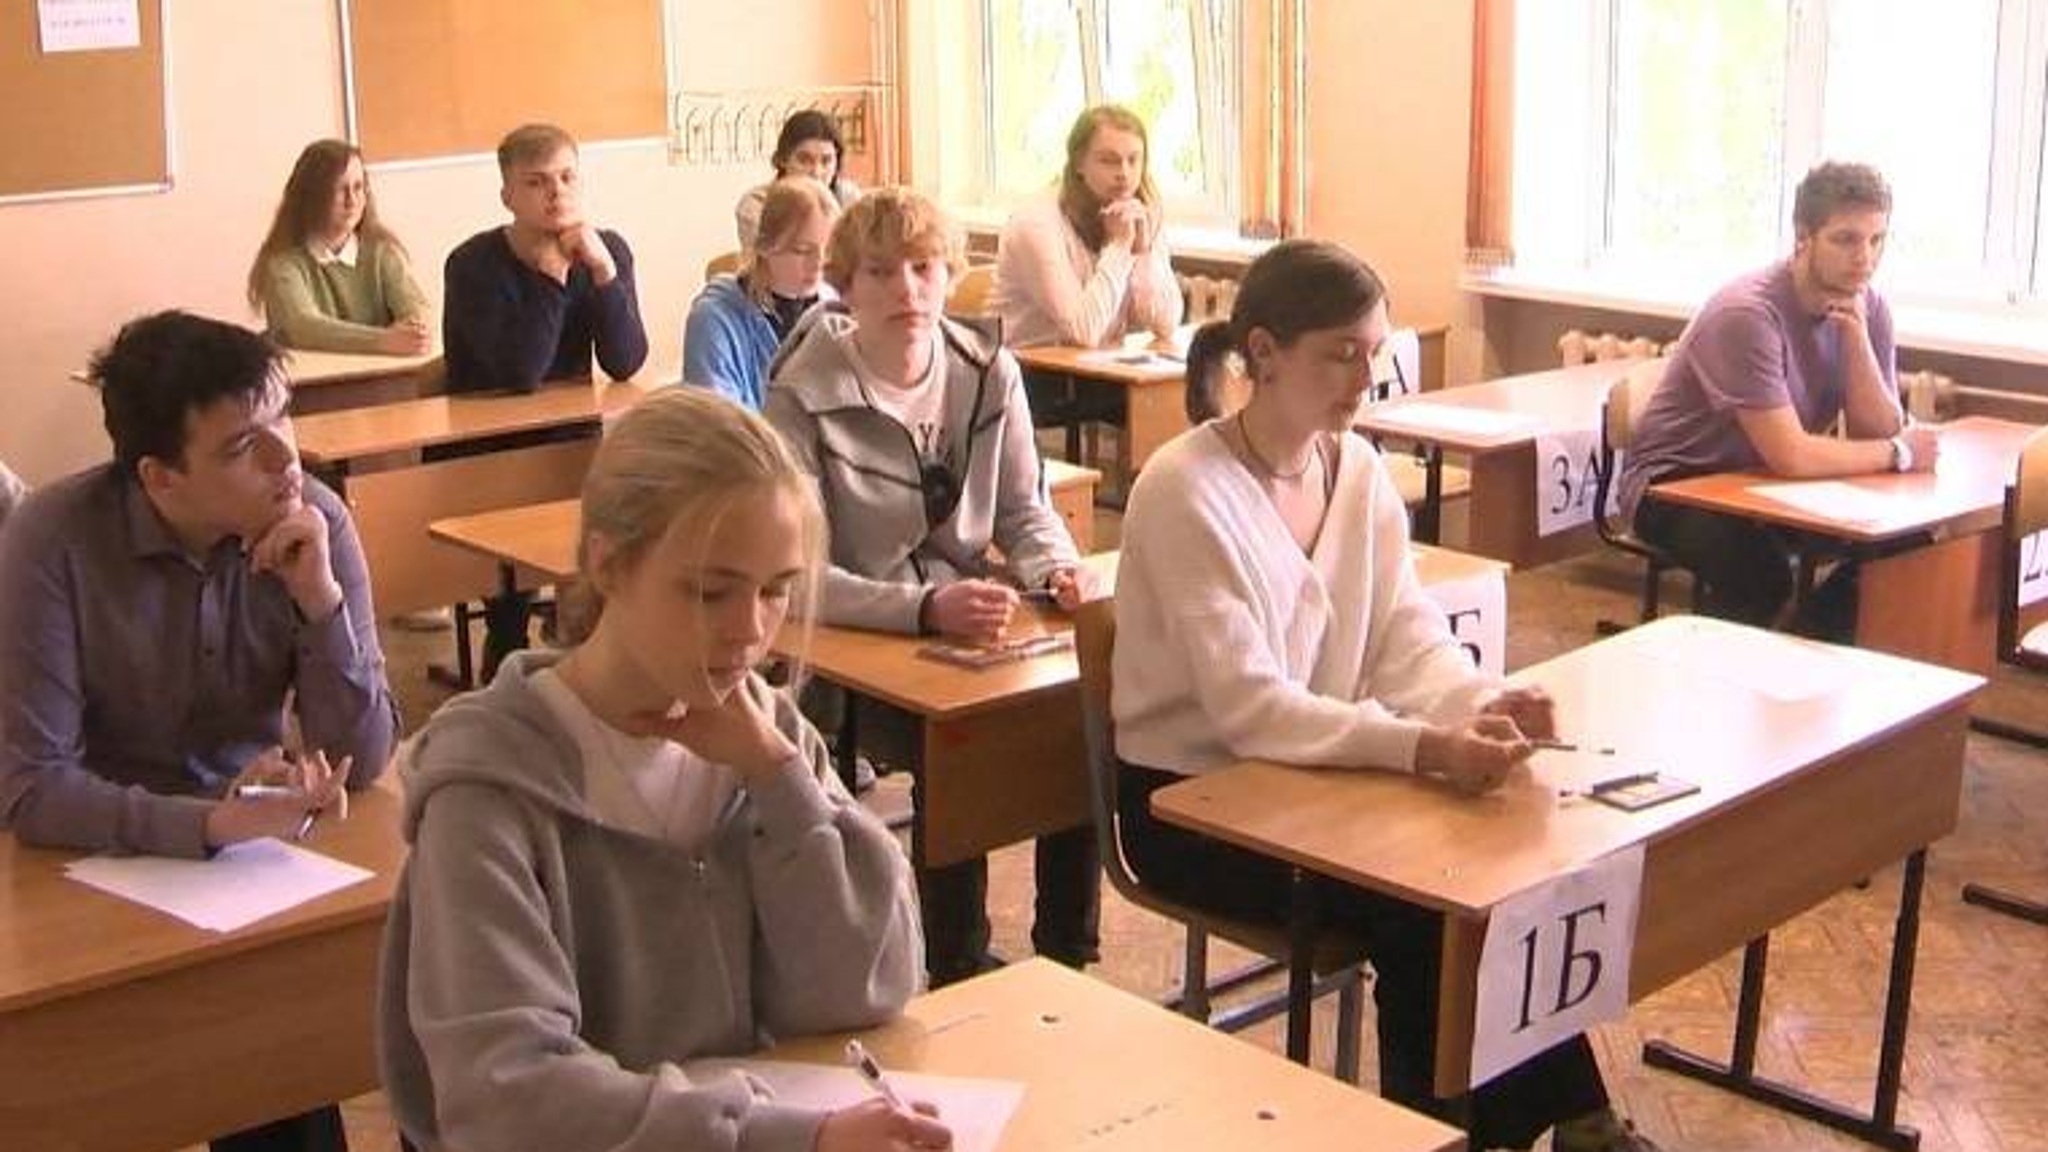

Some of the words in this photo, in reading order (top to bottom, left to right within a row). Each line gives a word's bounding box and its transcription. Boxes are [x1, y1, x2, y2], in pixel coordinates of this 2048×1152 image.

[1551, 448, 1608, 514] 3А
[1445, 608, 1481, 669] Б
[1512, 902, 1606, 1034] 1Б
